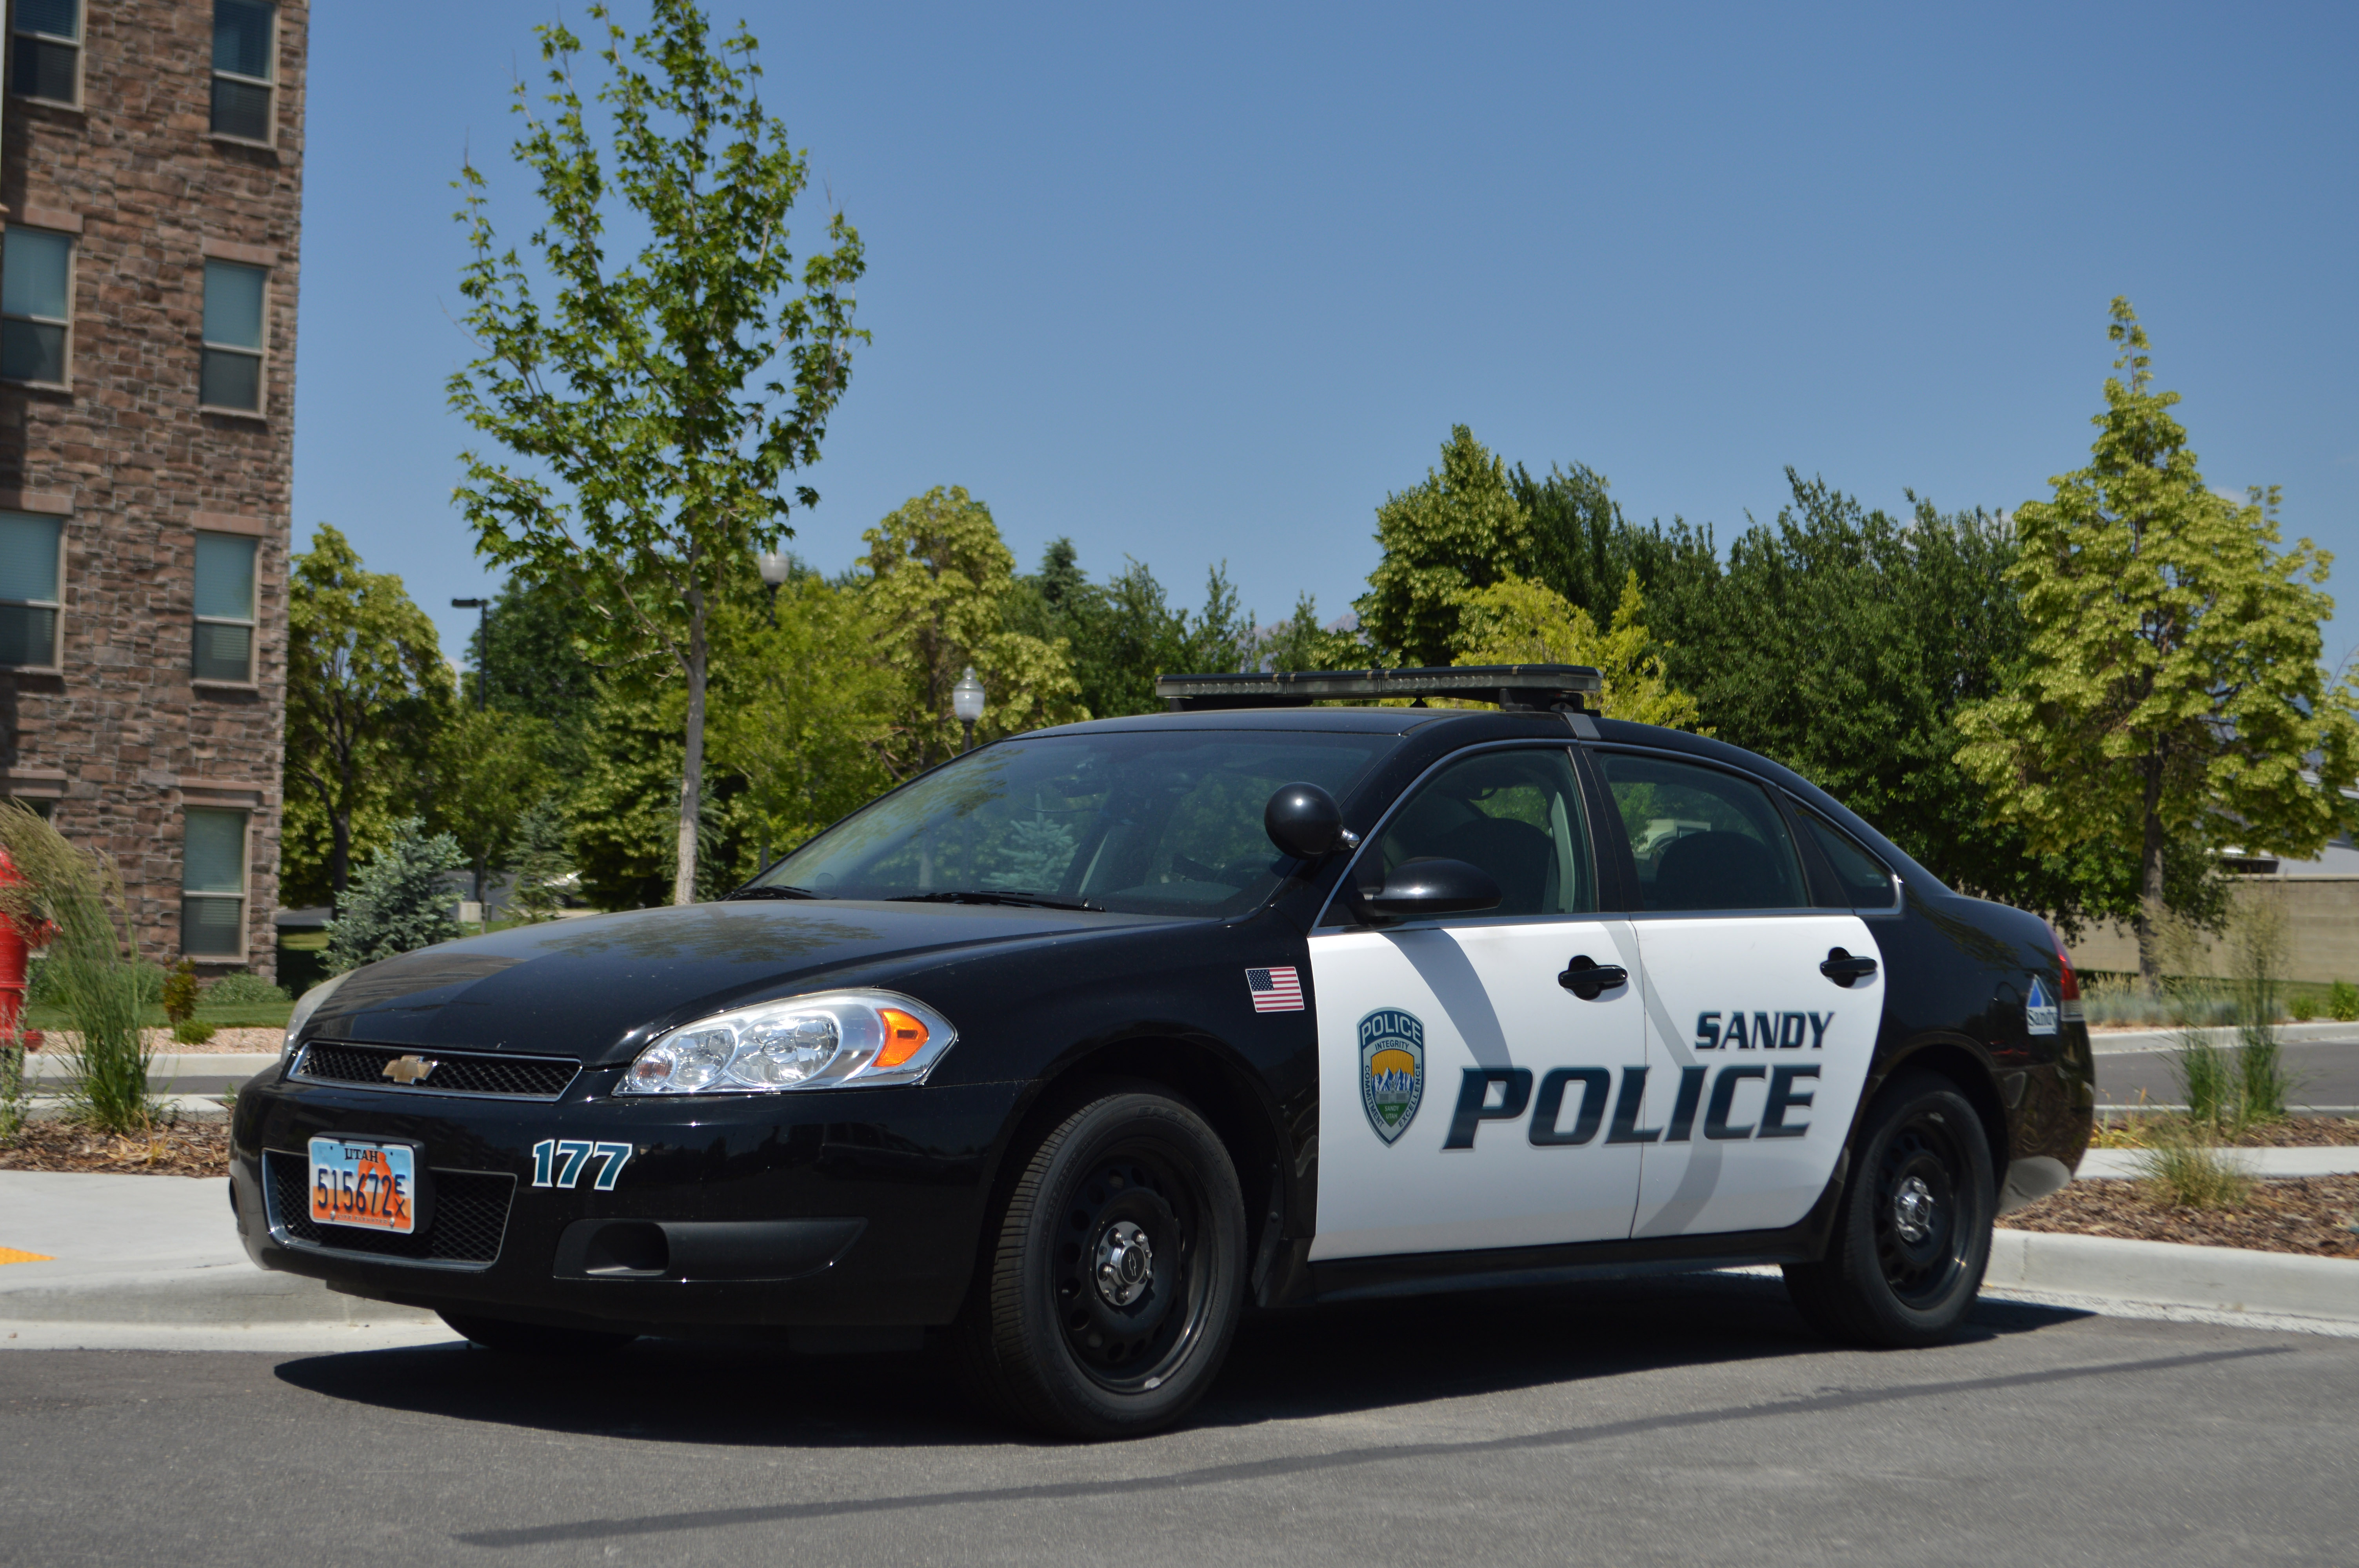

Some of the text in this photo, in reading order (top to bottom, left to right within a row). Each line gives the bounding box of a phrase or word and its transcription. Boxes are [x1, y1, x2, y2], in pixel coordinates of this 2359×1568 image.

[1362, 1014, 1421, 1046] POLICE
[1375, 1040, 1409, 1051] INTEGRITY
[1696, 1011, 1834, 1051] SANDY
[1365, 1065, 1384, 1128] COMMITMENT
[1398, 1063, 1421, 1128] EXCELLENCE
[1441, 1065, 1821, 1152] POLICE
[1137, 1105, 1204, 1139] EAGLE
[344, 1148, 379, 1163] UTAH
[532, 1139, 632, 1191] 177
[318, 1168, 392, 1216] 515672
[354, 1215, 388, 1225] ELEVATED
